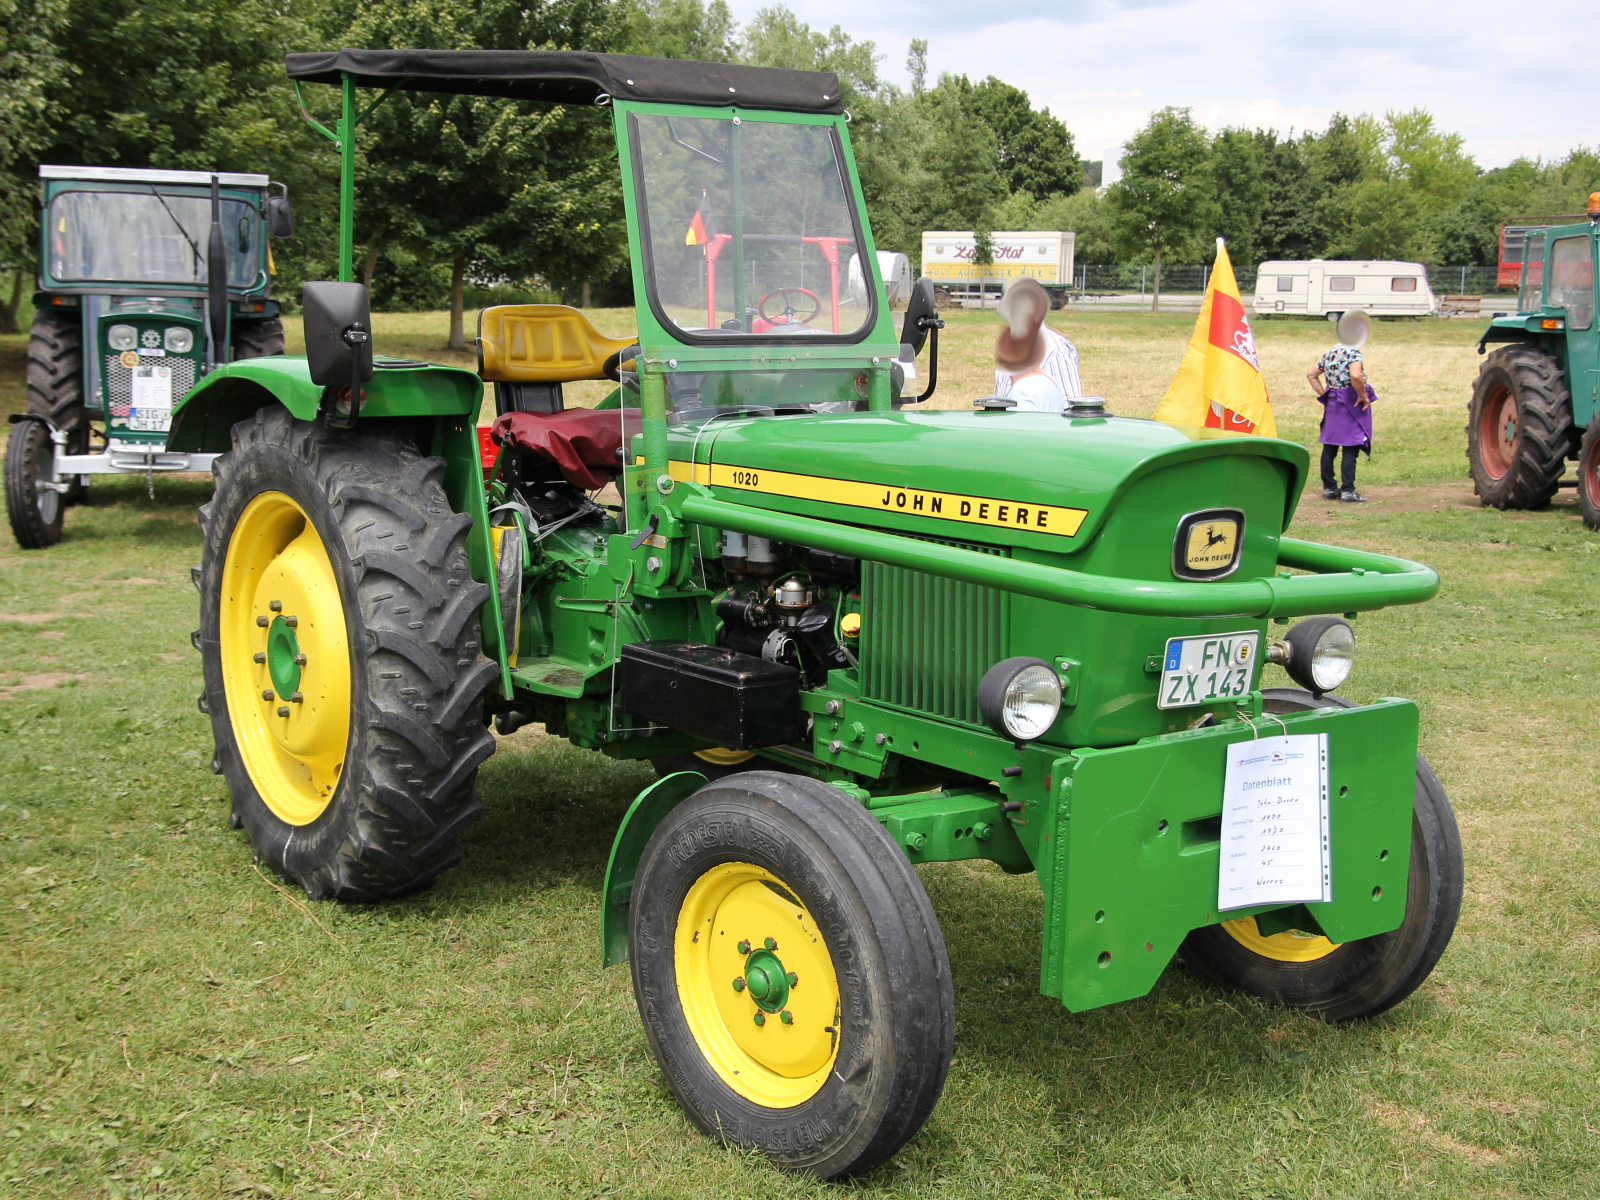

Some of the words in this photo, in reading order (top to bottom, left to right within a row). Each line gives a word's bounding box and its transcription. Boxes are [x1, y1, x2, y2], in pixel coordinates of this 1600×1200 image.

[957, 269, 976, 278] AUF
[137, 409, 159, 419] SIG
[132, 420, 148, 430] JH
[732, 471, 759, 487] 1020
[882, 490, 943, 514] JOHN
[959, 500, 1050, 528] DEERE
[1188, 556, 1210, 564] JOHN
[1211, 553, 1232, 562] DEERE
[1201, 638, 1233, 669] FN
[1169, 659, 1177, 669] D
[1166, 673, 1199, 704] ZX
[1204, 668, 1247, 699] 143
[1242, 776, 1293, 792] Datenblatt
[664, 820, 752, 870] VREDESTEIN
[1261, 859, 1274, 867] 45
